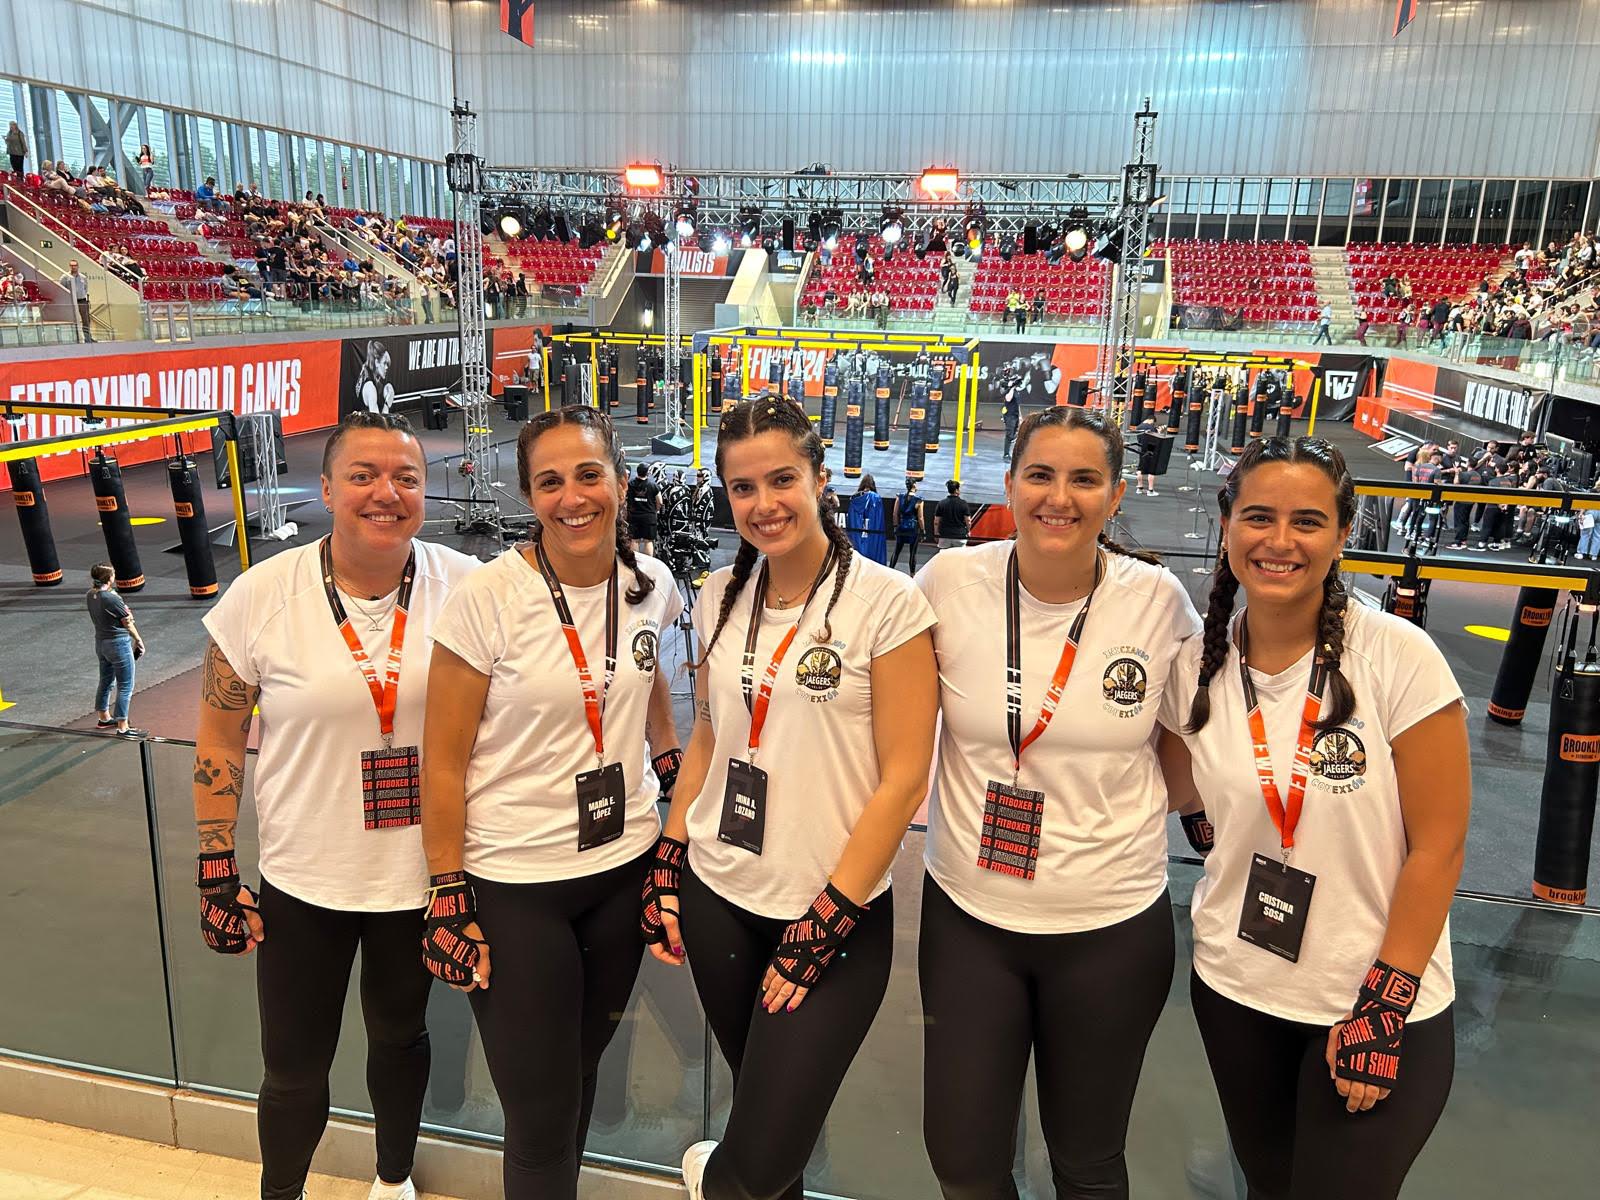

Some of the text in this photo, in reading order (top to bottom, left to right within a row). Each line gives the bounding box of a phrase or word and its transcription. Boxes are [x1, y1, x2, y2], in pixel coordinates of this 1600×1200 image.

[409, 340, 421, 371] WE
[421, 338, 436, 369] ARE
[436, 338, 448, 367] ON
[448, 337, 460, 366] THE
[159, 364, 235, 437] WORLD
[241, 358, 301, 417] GAMES
[604, 656, 616, 698] FW
[805, 676, 831, 686] JAEGERS
[1038, 682, 1064, 726] FWG
[1114, 690, 1138, 700] JAEGERS
[363, 761, 371, 769] ER
[375, 758, 407, 768] FITBOXER
[1323, 764, 1355, 775] JAEGERS
[364, 782, 372, 790] ER
[376, 779, 408, 789] FITBOXER
[378, 799, 409, 809] FITBOXER
[588, 797, 608, 812] MARÍA
[987, 792, 996, 801] ER
[999, 795, 1033, 810] FITBOXER
[593, 807, 611, 820] LÓPEZ
[735, 804, 756, 820] LOZANO
[366, 821, 374, 829] ER
[378, 817, 410, 827] FITBOXER
[985, 815, 993, 824] ER
[996, 817, 1030, 833] FITBOXER
[982, 837, 991, 846] ER
[994, 839, 1028, 855] FITBOXER
[202, 858, 230, 880] SHINE
[978, 859, 987, 868] ER
[991, 861, 1024, 877] FITBOXER
[813, 891, 839, 923] SHINE
[1258, 891, 1294, 914] CRISTINA
[207, 904, 229, 930] TIME
[1263, 906, 1284, 923] SOSA
[797, 920, 814, 942] TIME
[432, 926, 458, 955] SHINE
[453, 940, 470, 964] TO
[1342, 1016, 1377, 1047] SHINE
[1368, 1051, 1400, 1080] SHINE
